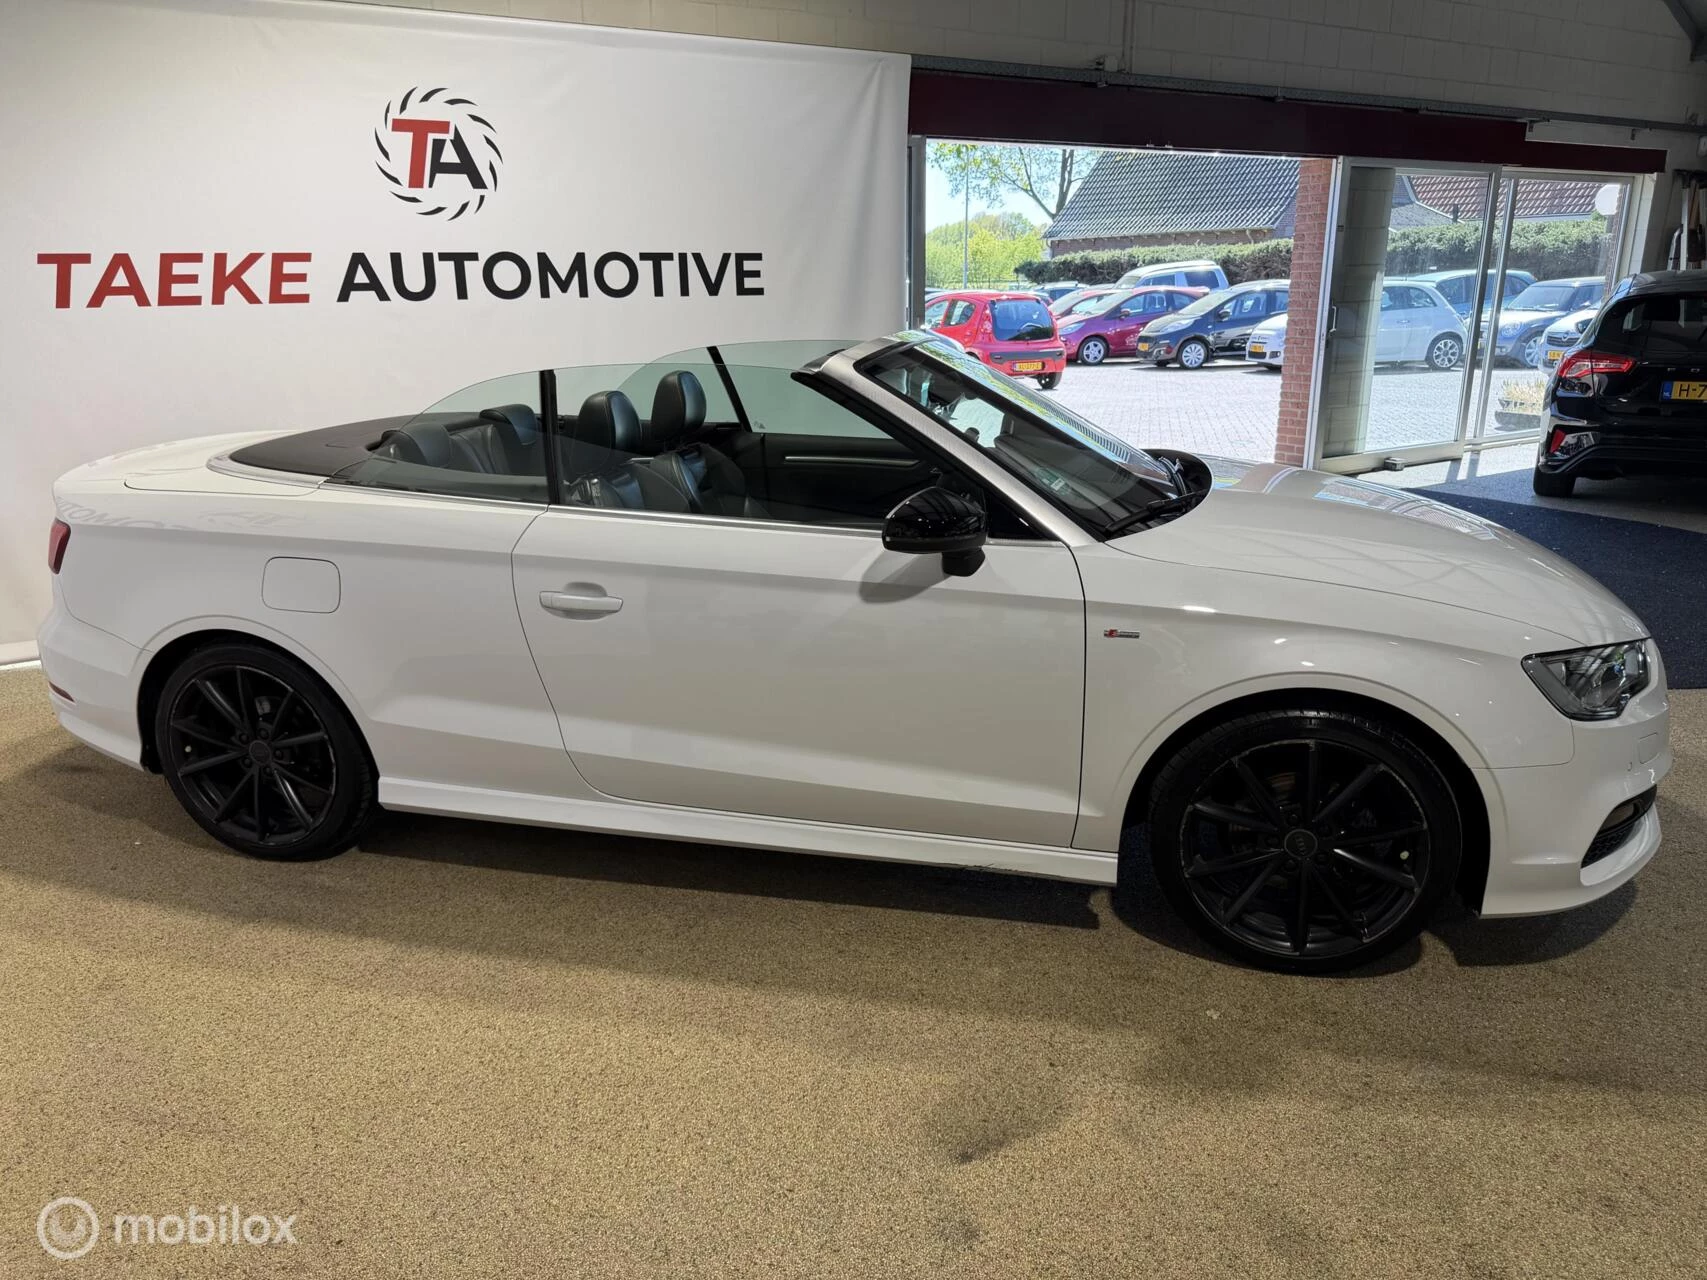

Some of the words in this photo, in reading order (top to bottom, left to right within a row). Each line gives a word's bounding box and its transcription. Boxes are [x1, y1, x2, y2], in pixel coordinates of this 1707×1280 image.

[391, 118, 489, 190] TA
[37, 252, 313, 309] TAEKE
[336, 251, 765, 303] AUTOMOTIVE
